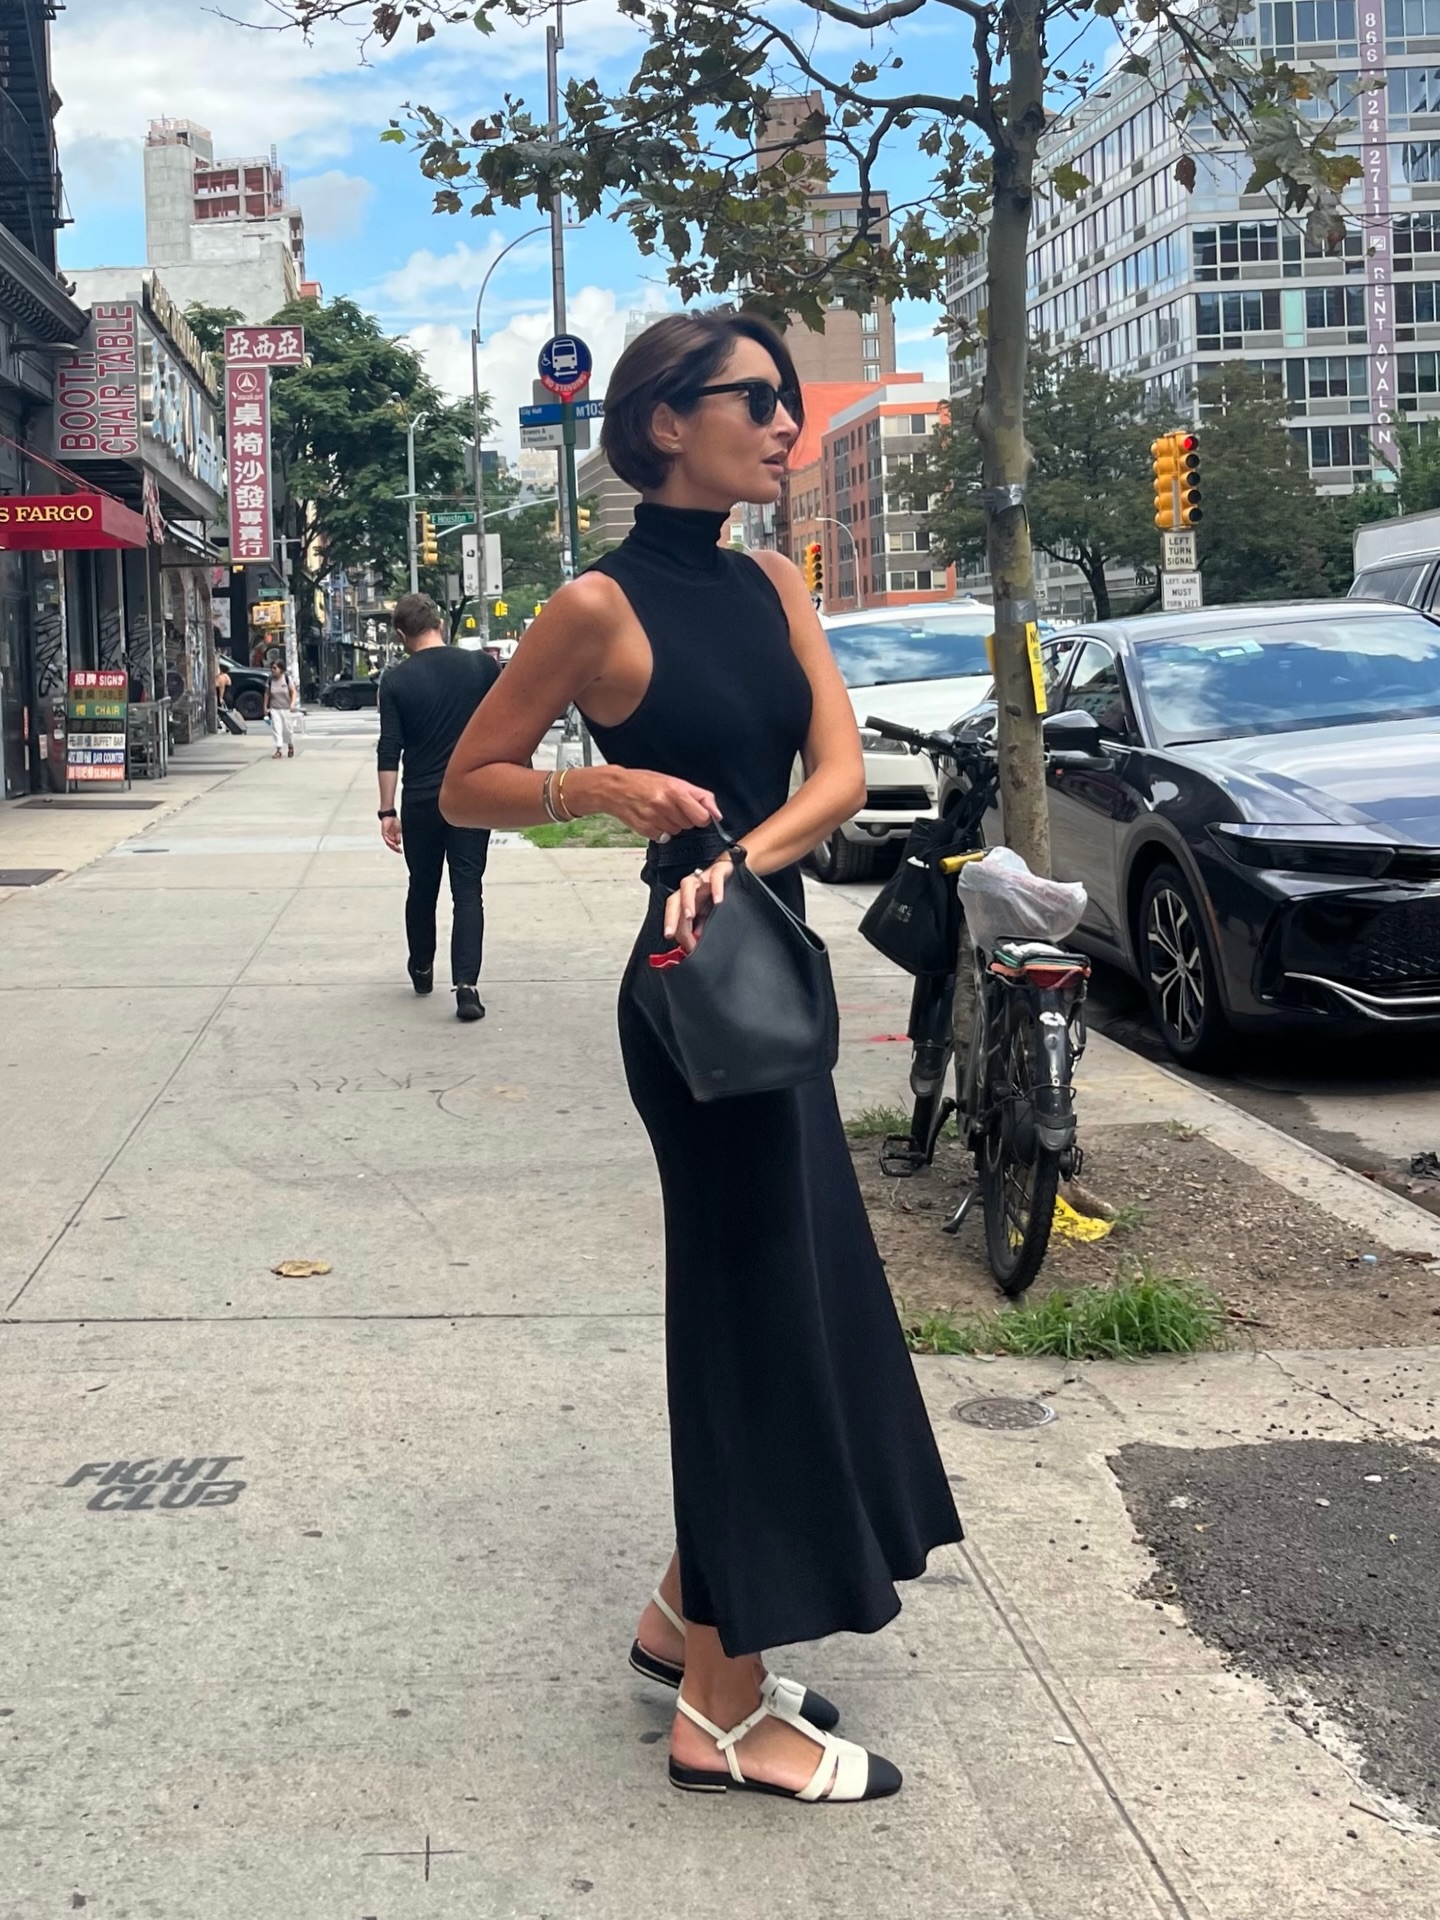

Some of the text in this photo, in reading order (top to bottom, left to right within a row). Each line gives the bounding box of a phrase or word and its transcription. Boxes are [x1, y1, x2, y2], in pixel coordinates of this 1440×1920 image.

[227, 330, 302, 361] 亞西亞
[1373, 267, 1391, 444] RENT AVALON
[95, 304, 139, 456] CHAIR TABLE
[554, 374, 588, 392] STANDING
[57, 351, 98, 452] BOOTH
[576, 403, 605, 417] M103
[15, 505, 94, 523] FARGO
[437, 514, 467, 524] Houston
[1169, 537, 1189, 545] LEFT
[1167, 557, 1193, 565] SIGNAL
[1172, 588, 1191, 596] MUST
[1166, 599, 1199, 608] TURN LEFT
[99, 690, 123, 700] TABLE
[95, 706, 119, 716] CHAIR
[93, 736, 112, 746] BUFFET
[56, 1455, 245, 1488] FIGHT
[86, 1479, 247, 1512] CLUB
